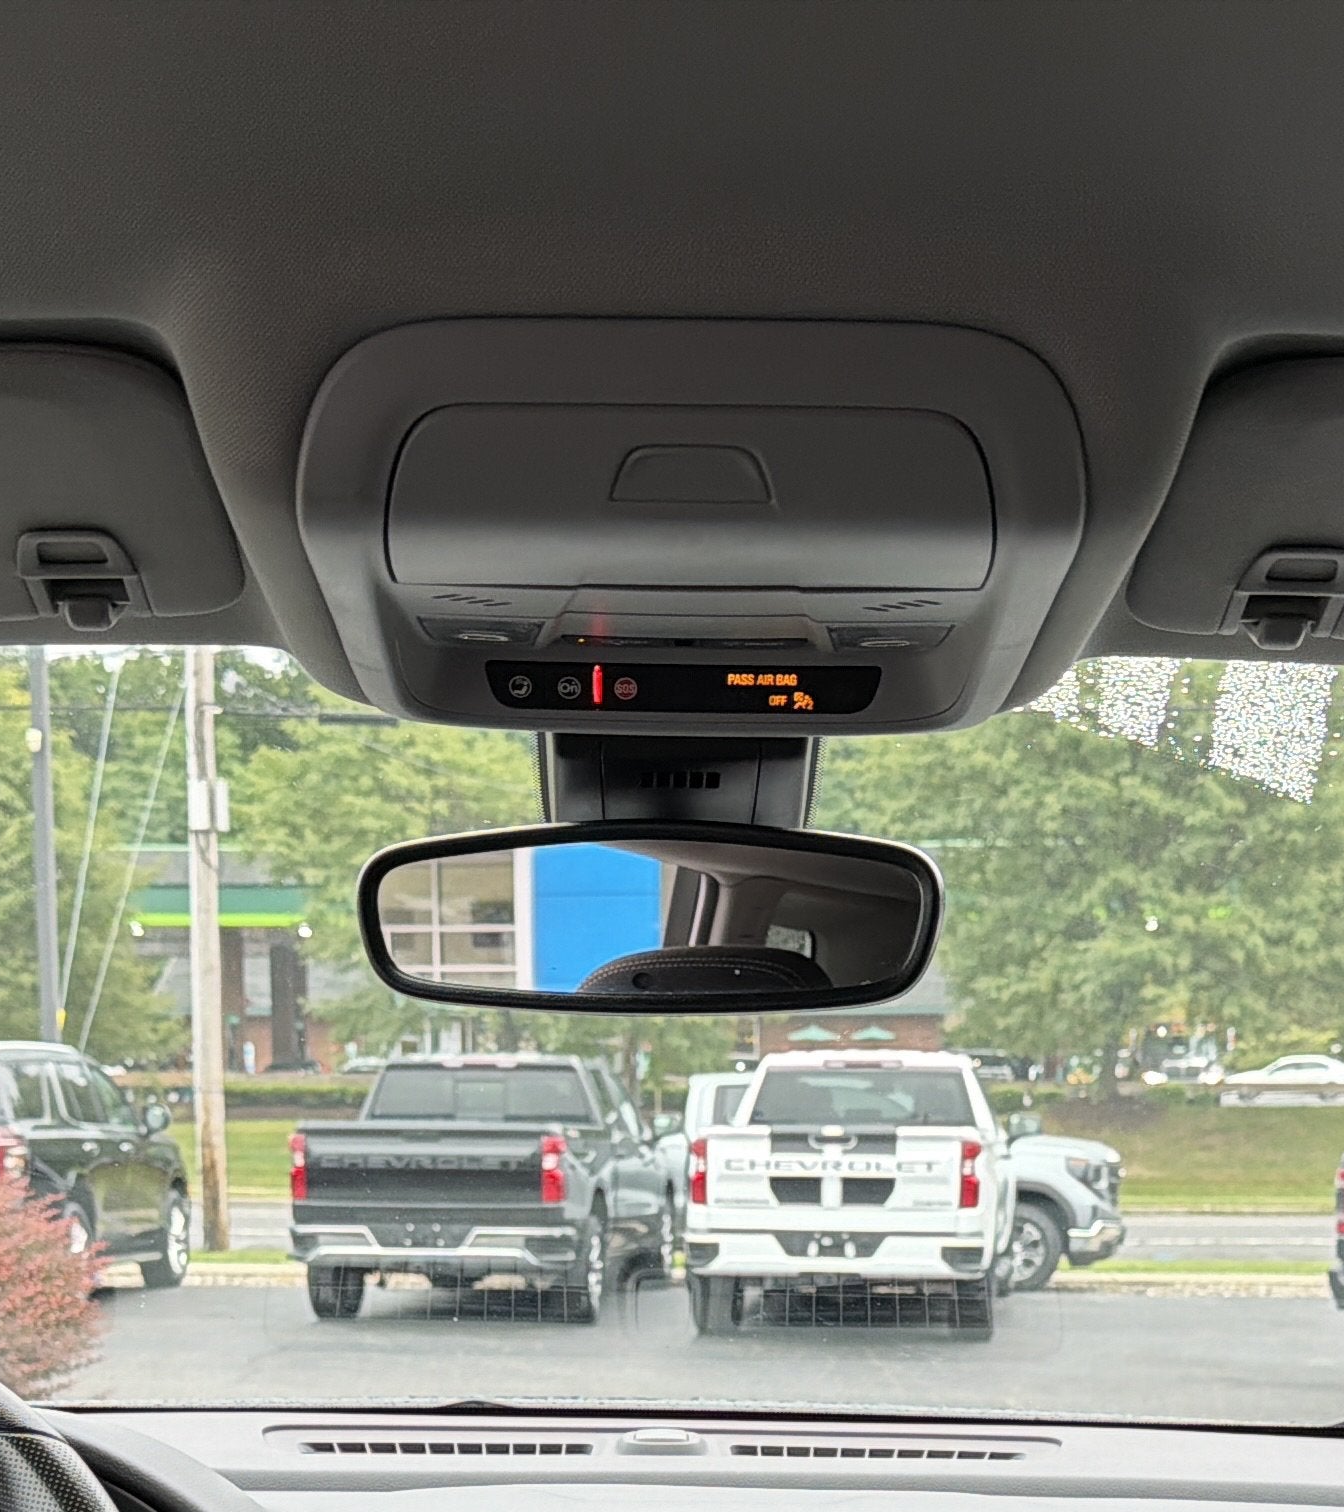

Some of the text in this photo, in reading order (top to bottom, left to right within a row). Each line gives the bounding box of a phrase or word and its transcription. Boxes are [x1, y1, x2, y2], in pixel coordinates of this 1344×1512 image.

[727, 674, 798, 687] PASS AIR BAG
[615, 683, 636, 694] SOS
[769, 695, 788, 706] OFF
[319, 1153, 523, 1171] CHEVROLET
[723, 1158, 941, 1175] CHEVROLET
